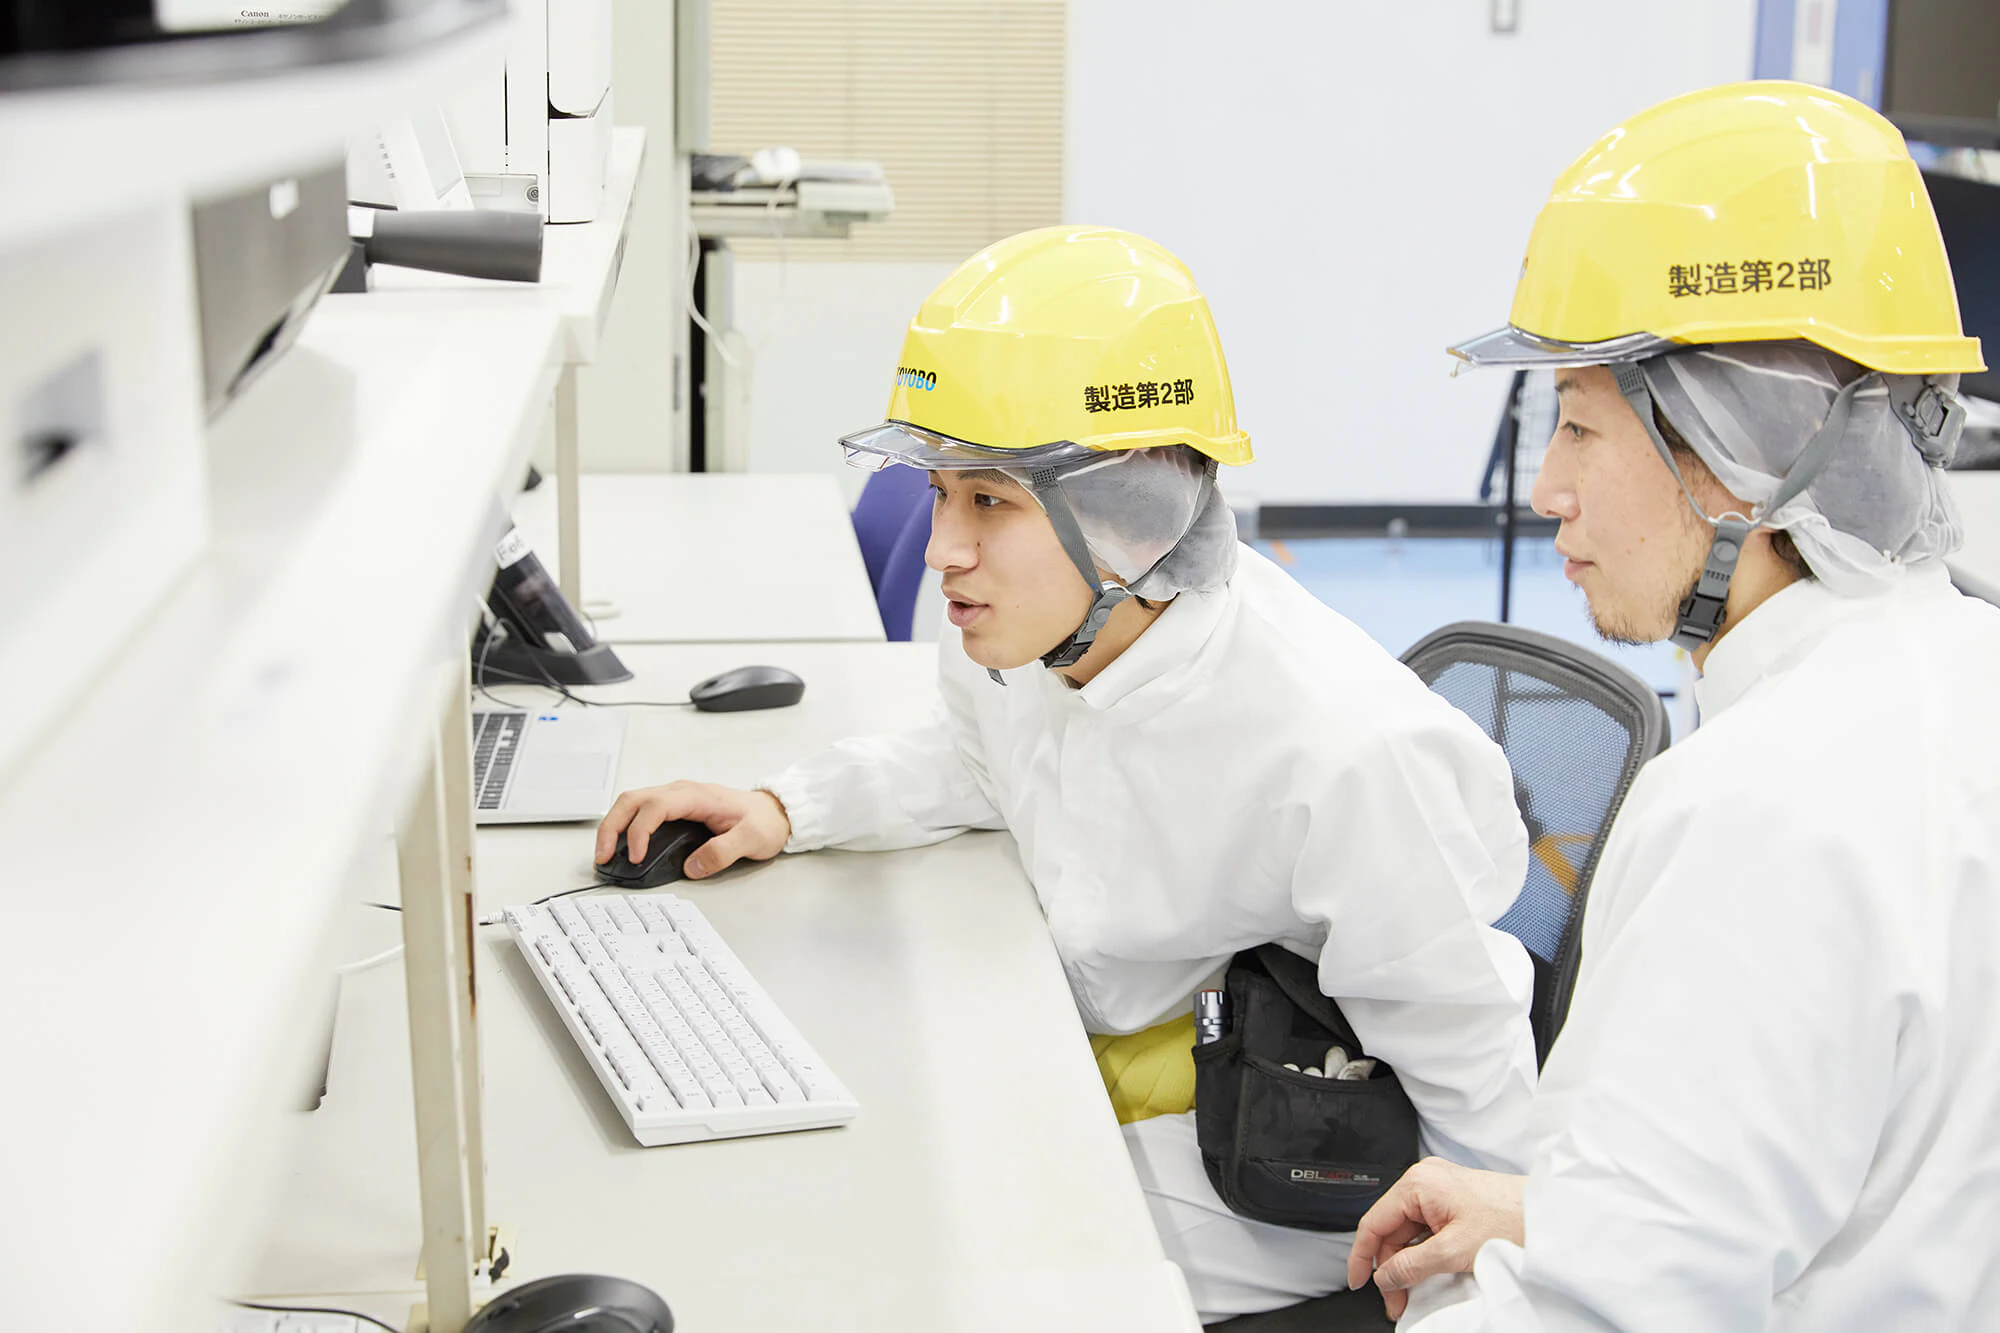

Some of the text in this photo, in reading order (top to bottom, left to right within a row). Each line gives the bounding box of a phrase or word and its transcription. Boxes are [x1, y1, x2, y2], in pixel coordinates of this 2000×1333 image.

[240, 9, 270, 18] Canon
[1669, 258, 1832, 298] 製造第2部
[1084, 378, 1194, 413] 製造第2部
